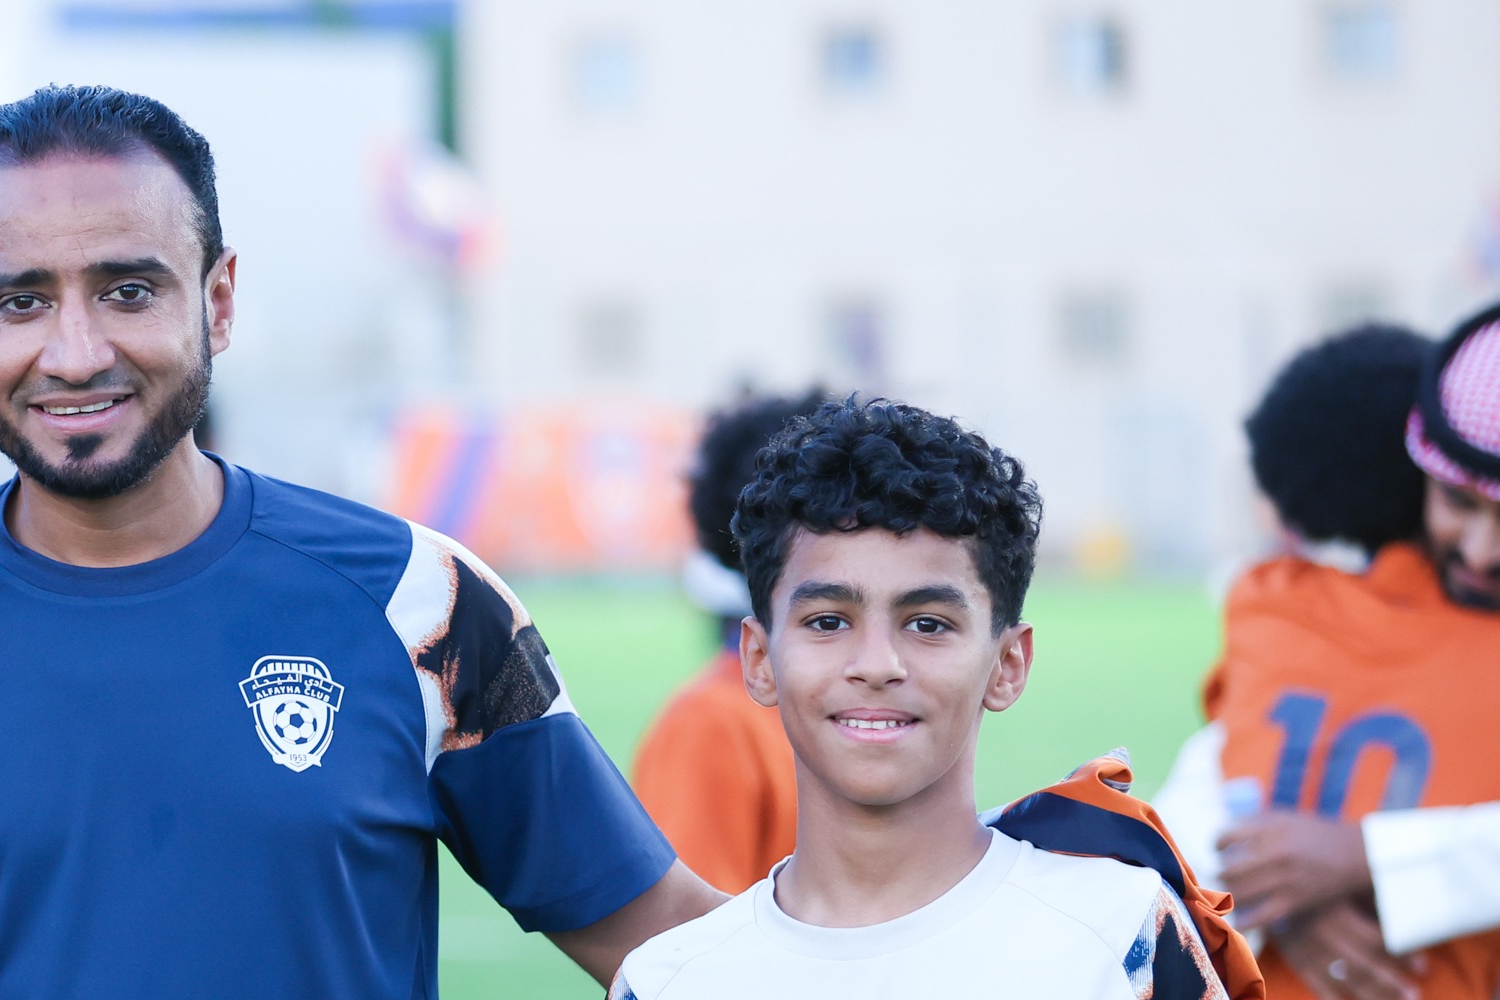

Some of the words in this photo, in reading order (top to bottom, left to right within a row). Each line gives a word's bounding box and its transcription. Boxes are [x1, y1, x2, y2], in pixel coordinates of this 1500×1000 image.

[252, 673, 303, 690] الفيحاء
[304, 677, 334, 693] نادي
[256, 686, 301, 700] ALFAYHA
[304, 688, 330, 703] CLUB
[289, 754, 307, 762] 1953
[1269, 694, 1431, 821] 10
